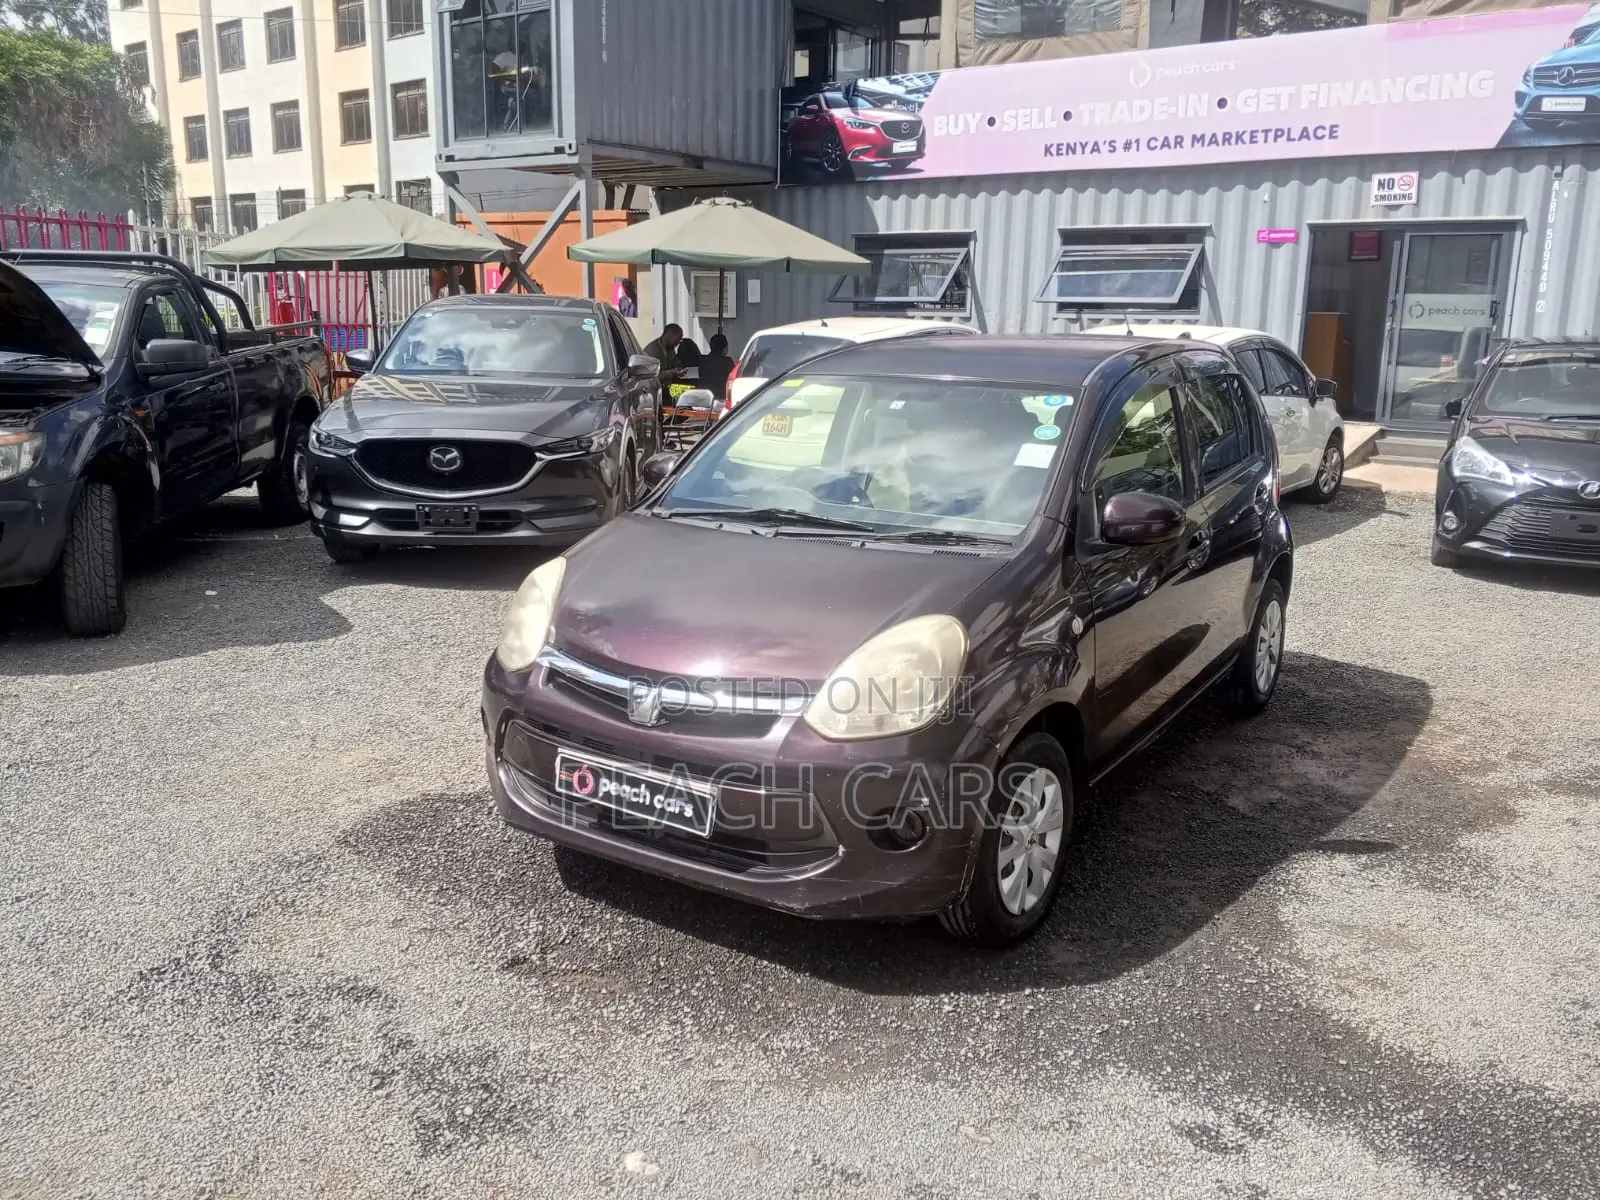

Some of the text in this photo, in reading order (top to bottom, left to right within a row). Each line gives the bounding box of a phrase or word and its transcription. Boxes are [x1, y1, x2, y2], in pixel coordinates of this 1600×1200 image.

[1157, 59, 1236, 82] peach cars
[934, 70, 1495, 137] BUY SELL TRADE-IN GET FINANCING
[1043, 124, 1340, 157] KENYA’S #1 CAR MARKETPLACE
[1377, 177, 1396, 191] NO
[1374, 192, 1413, 202] SMOKING
[1428, 305, 1485, 317] peach cars
[598, 777, 694, 818] peach cars
